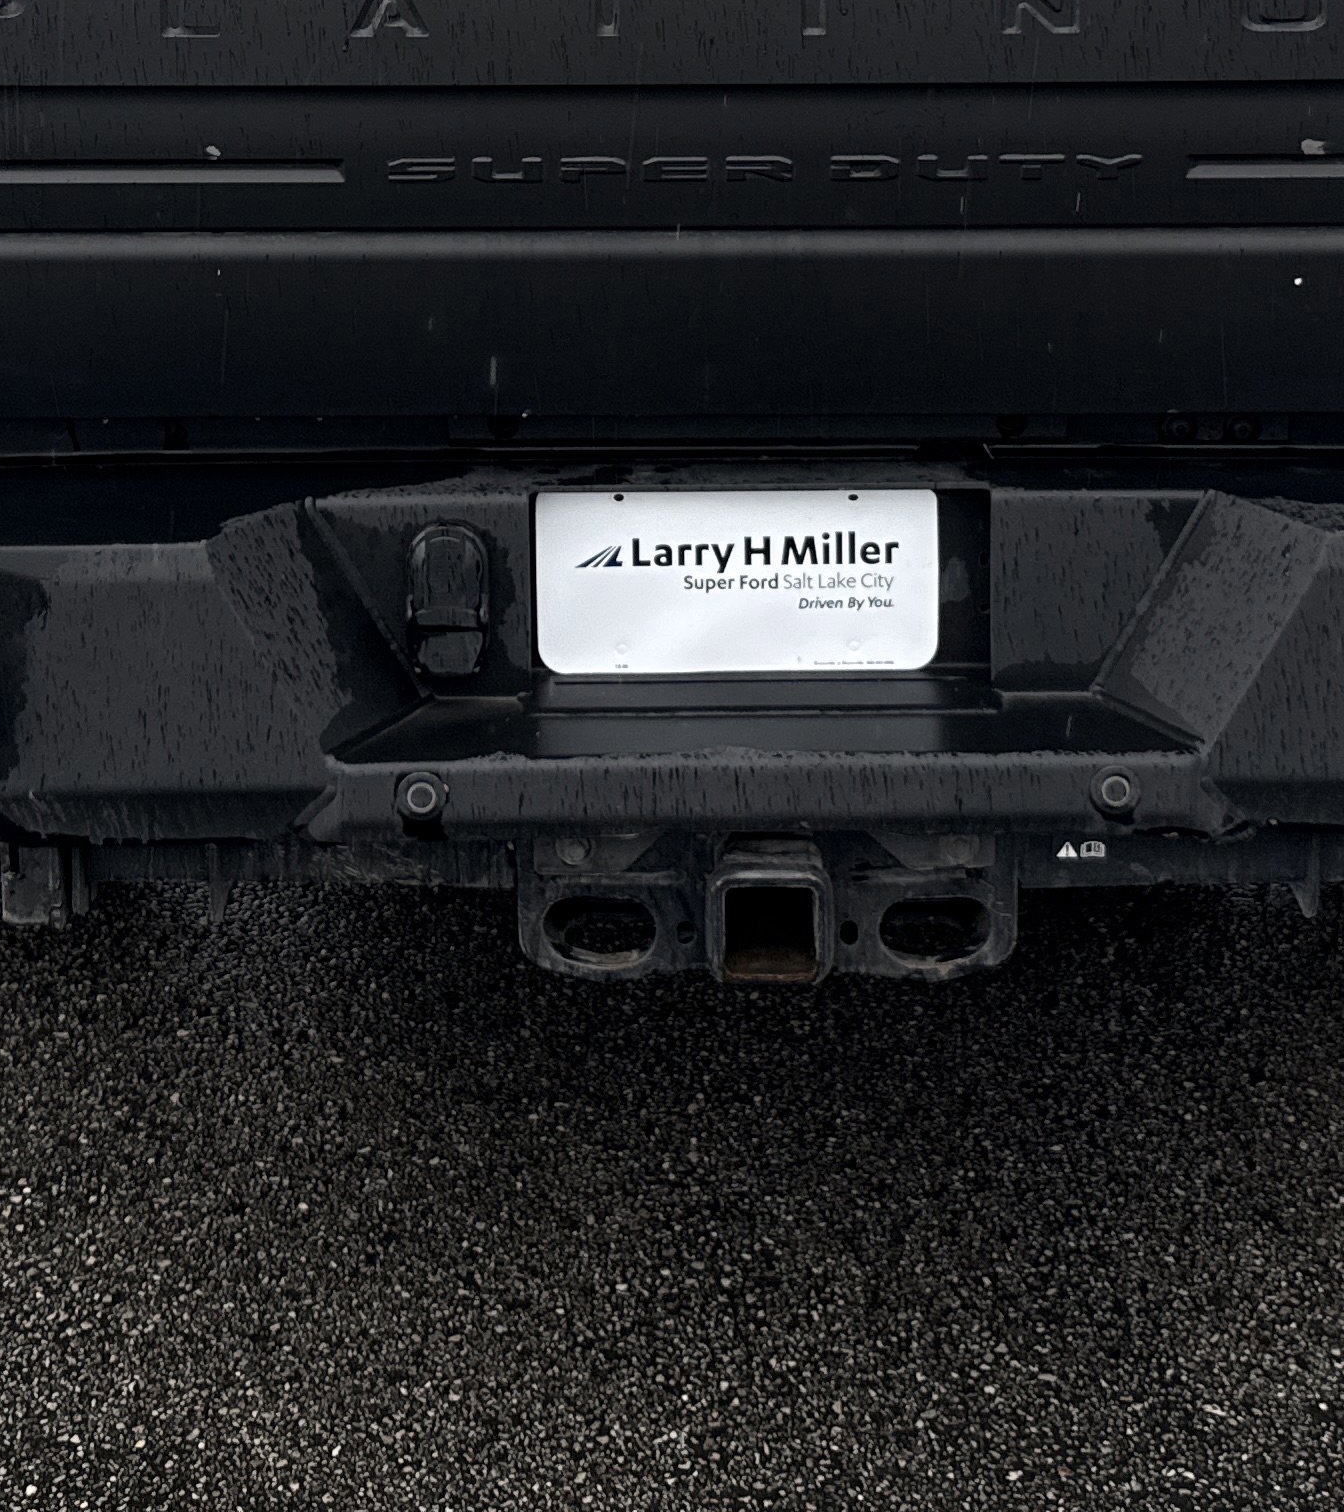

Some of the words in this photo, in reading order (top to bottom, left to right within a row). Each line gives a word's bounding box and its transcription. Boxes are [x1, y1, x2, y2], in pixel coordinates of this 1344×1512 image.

[388, 156, 794, 183] SUPER
[830, 154, 1144, 181] DUTY
[631, 537, 735, 574] Larry
[743, 536, 772, 566] H
[781, 530, 900, 566] Miller
[683, 575, 735, 594] Super
[739, 572, 779, 590] Ford
[783, 573, 814, 590] Salt
[817, 572, 858, 589] Lake
[860, 572, 895, 591] City
[798, 597, 844, 610] Driven
[847, 596, 865, 611] By
